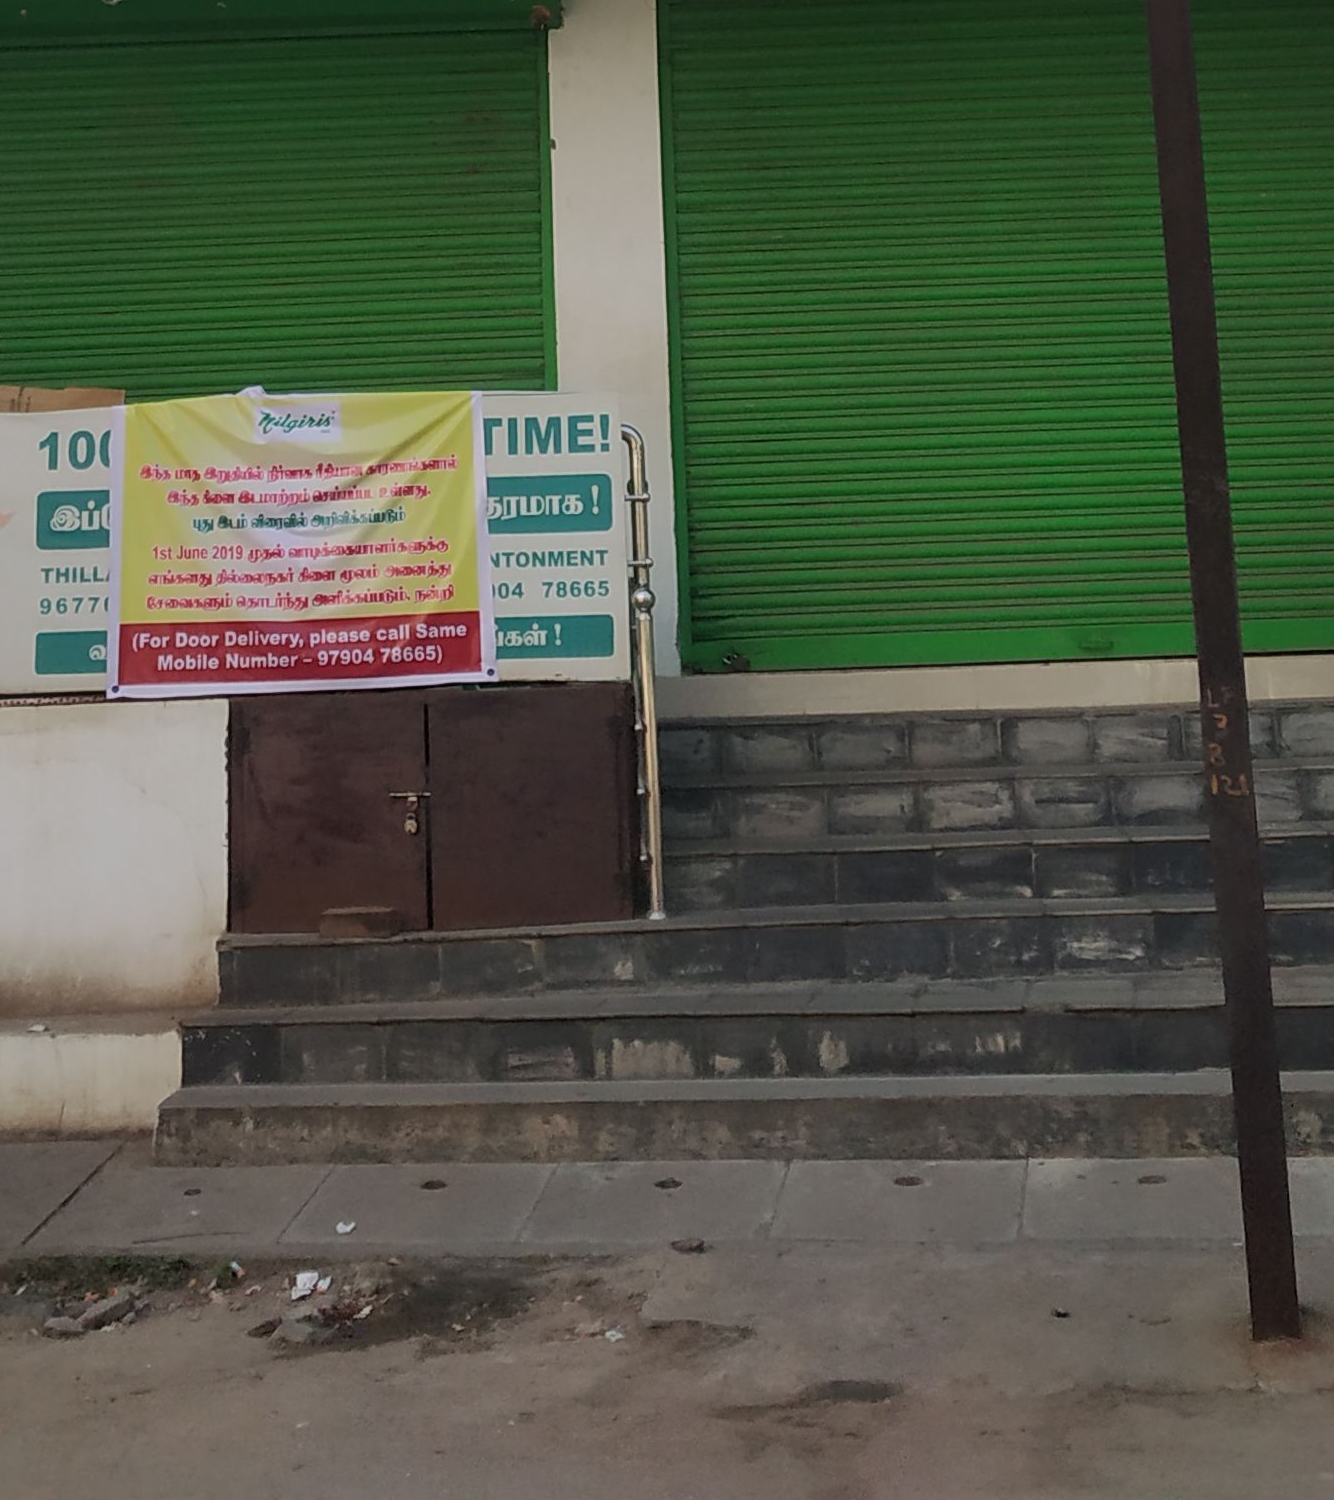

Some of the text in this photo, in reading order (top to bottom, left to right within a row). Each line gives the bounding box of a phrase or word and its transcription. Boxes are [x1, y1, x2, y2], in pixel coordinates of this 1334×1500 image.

[258, 411, 332, 434] Nilgiris
[140, 465, 171, 479] இந்த
[168, 490, 199, 506] இந்த
[153, 546, 172, 560] 1st
[177, 546, 208, 560] June
[213, 546, 244, 559] 2019
[491, 550, 608, 567] NTONMENT
[542, 580, 610, 598] 78665
[40, 597, 108, 614] 9677
[132, 623, 467, 652] (For Door Delivery, please call Same
[157, 653, 219, 671] Mobile
[225, 653, 298, 670] Number
[317, 647, 375, 666] 97904
[380, 644, 443, 664] 78665)
